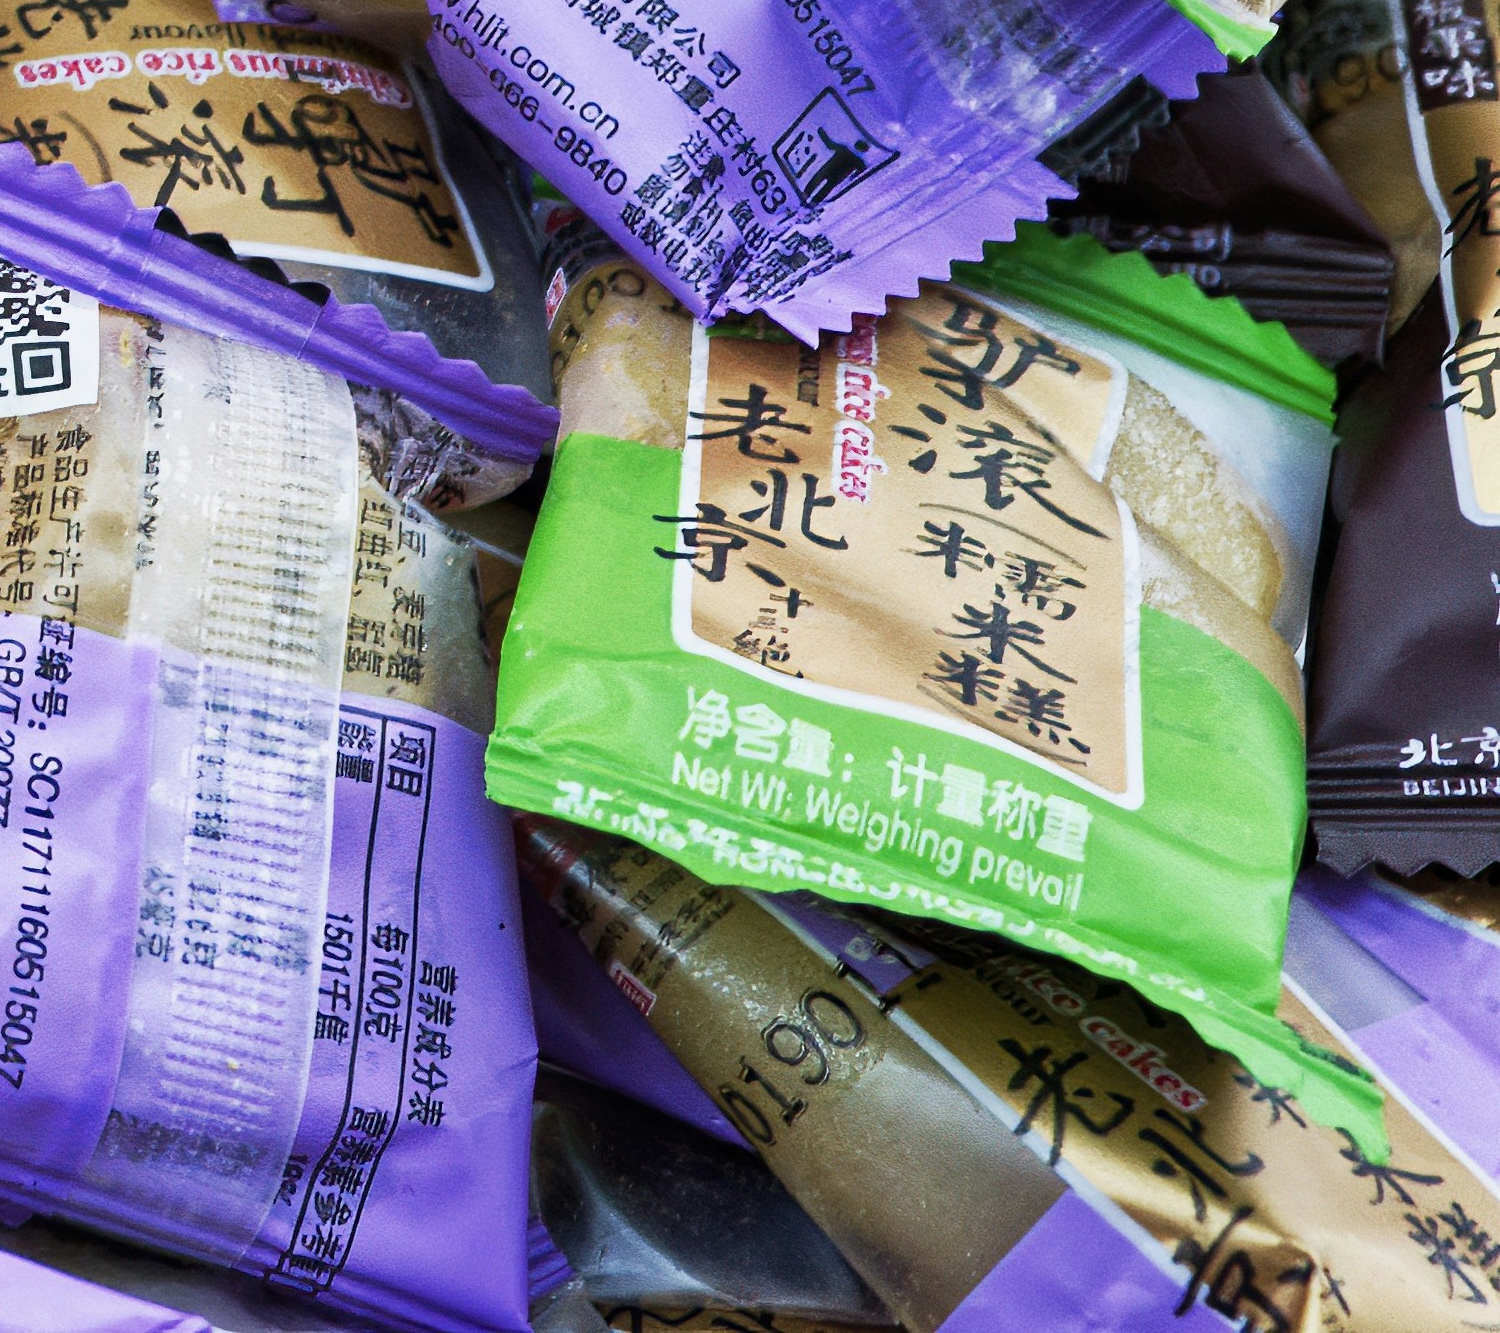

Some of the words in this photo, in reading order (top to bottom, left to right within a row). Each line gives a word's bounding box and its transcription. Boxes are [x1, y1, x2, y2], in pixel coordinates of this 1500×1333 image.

[20, 54, 127, 88] cakes
[142, 50, 217, 85] rice
[652, 382, 849, 587] 老北京
[670, 750, 733, 797] Net
[803, 786, 967, 874] Weighing
[969, 845, 1087, 915] prevail
[885, 745, 1093, 864] 计量称重
[1083, 1015, 1205, 1114] cakes
